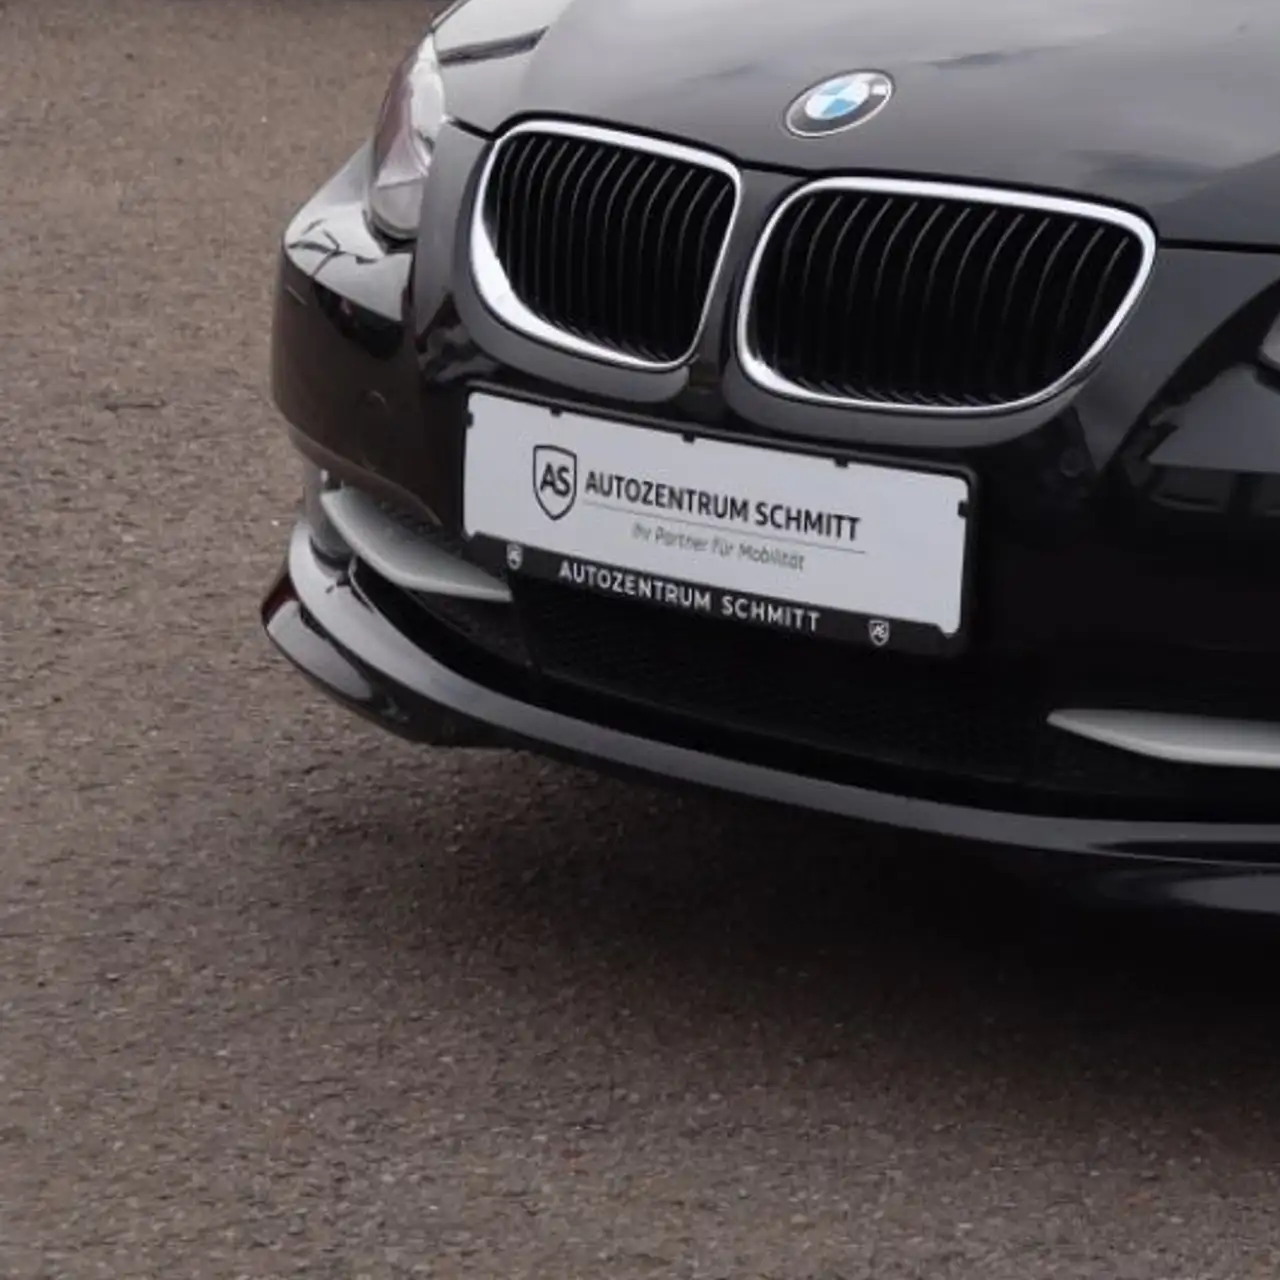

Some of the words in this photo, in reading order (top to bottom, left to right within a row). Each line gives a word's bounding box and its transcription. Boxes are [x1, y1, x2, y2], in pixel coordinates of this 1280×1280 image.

[540, 463, 571, 497] AS
[585, 471, 749, 522] AUTOZENTRUM
[755, 502, 862, 542] SCHMITT
[655, 526, 708, 551] Partner
[712, 535, 734, 557] für
[738, 542, 805, 570] Mobilität
[558, 560, 711, 611] AUTOZENTRUM
[721, 595, 821, 633] SCHMITT
